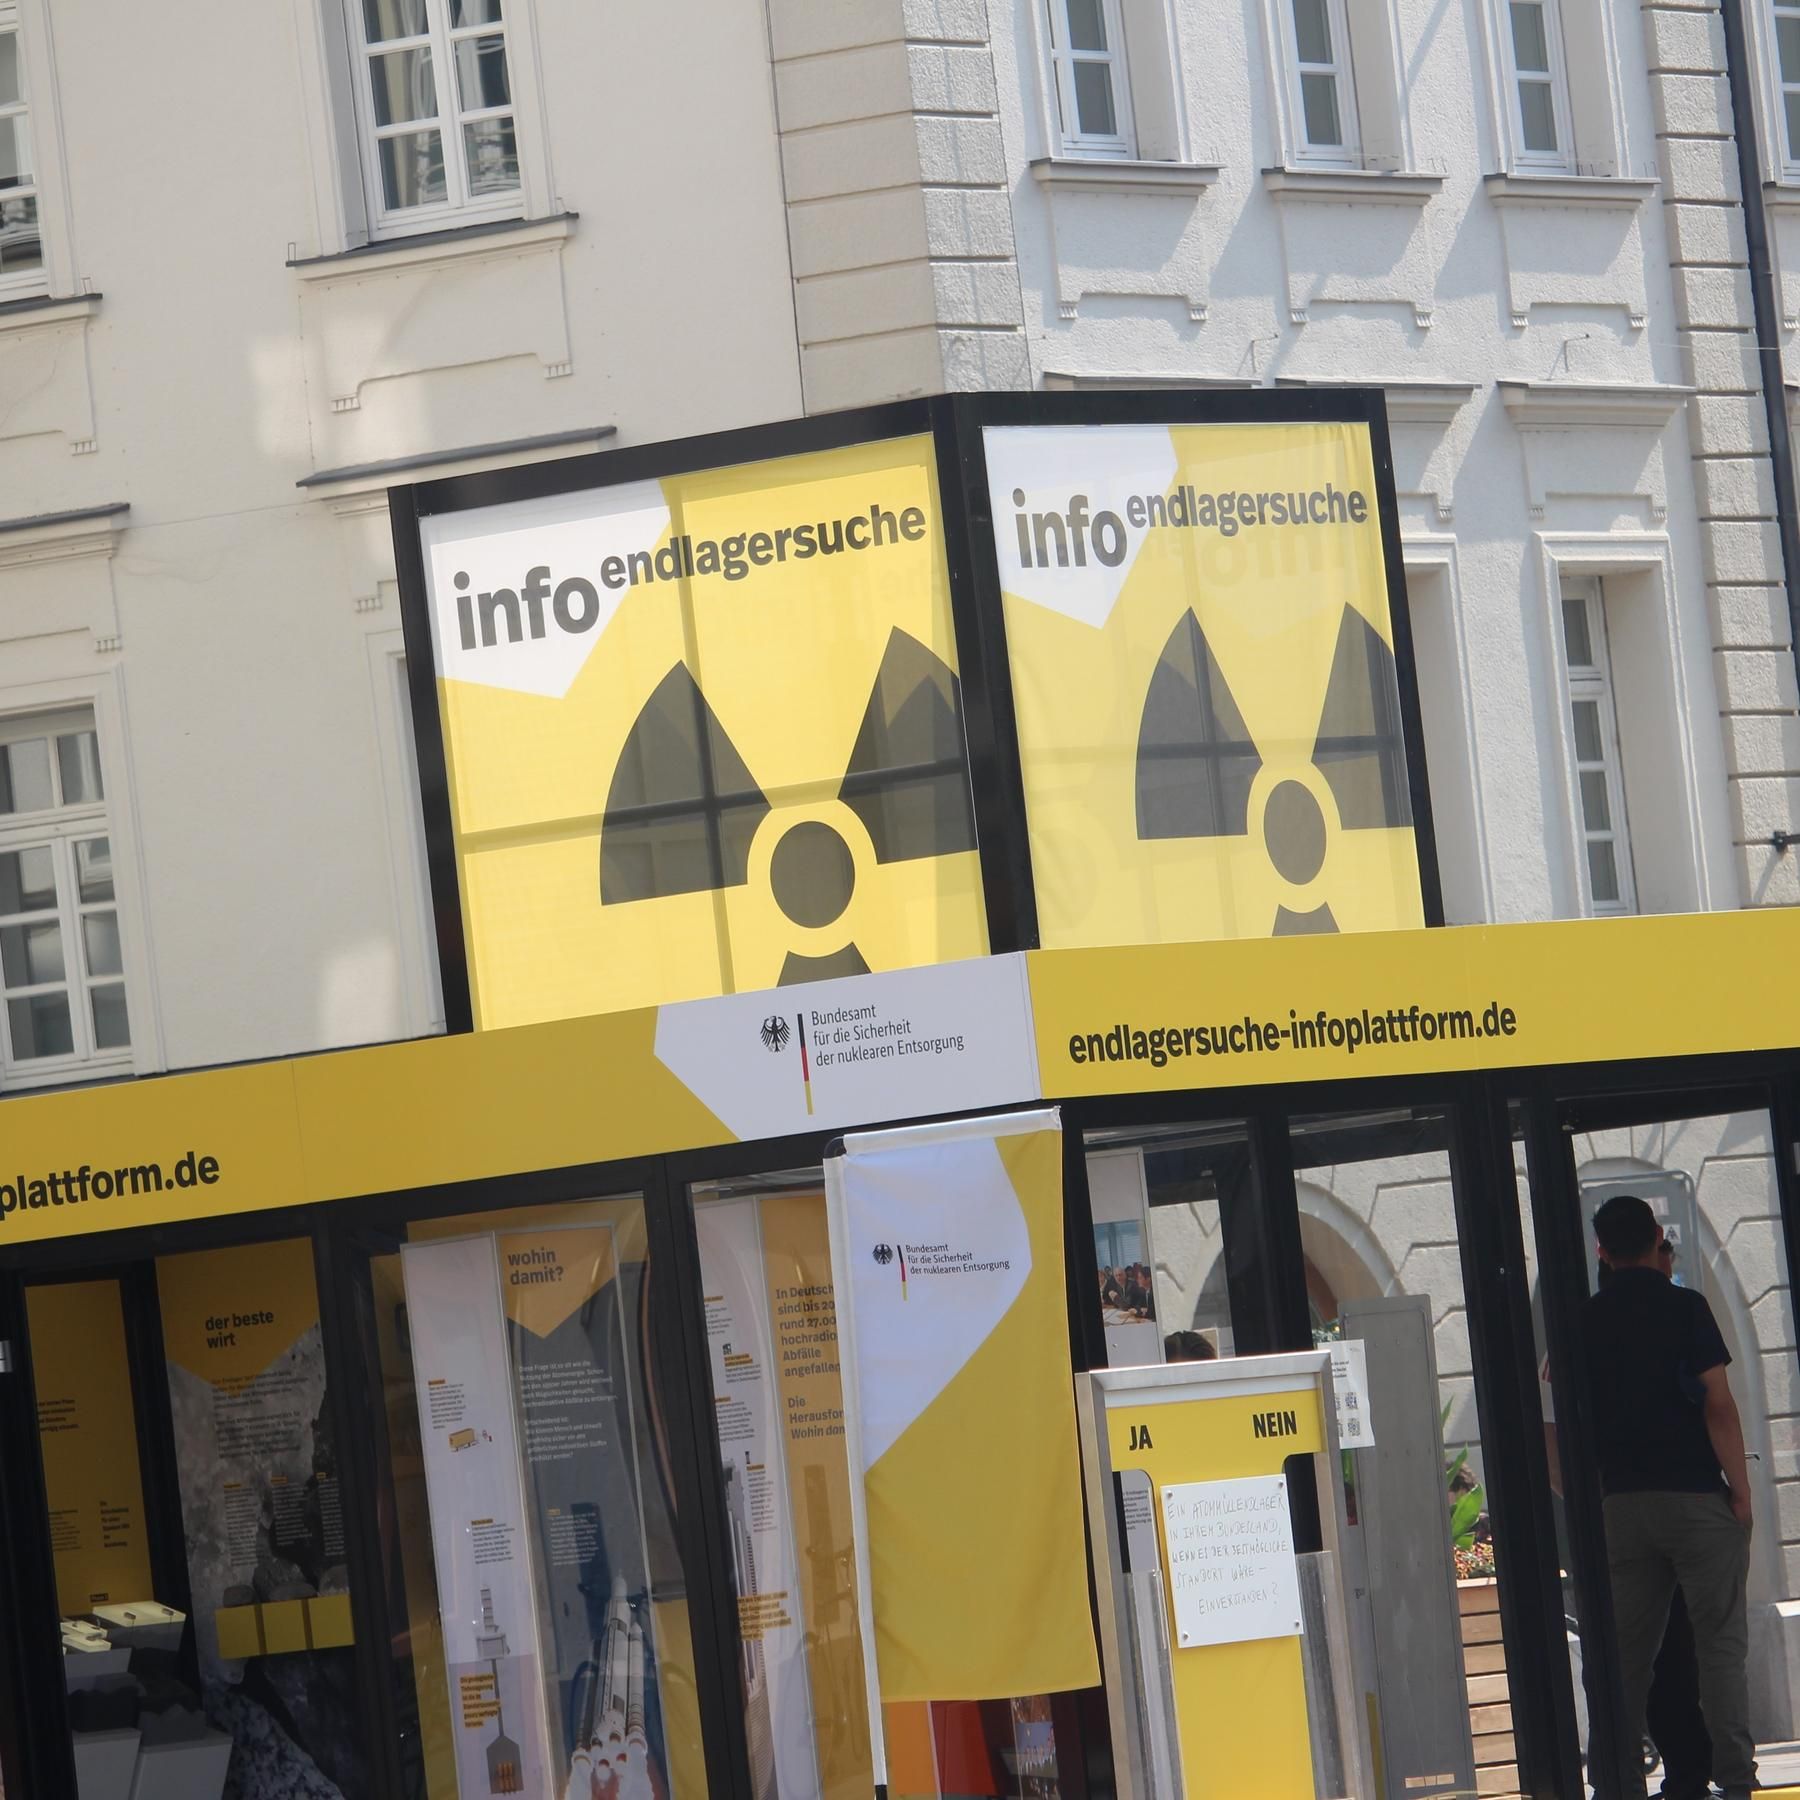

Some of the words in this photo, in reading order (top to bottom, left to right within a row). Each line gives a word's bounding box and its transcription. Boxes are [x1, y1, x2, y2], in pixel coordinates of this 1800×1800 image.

[1012, 488, 1128, 568] info
[1126, 483, 1368, 537] endlagersuche
[453, 566, 600, 650] info
[600, 504, 927, 589] endlagersuche
[811, 1005, 877, 1026] Bundesamt
[813, 1030, 830, 1046] für
[833, 1026, 851, 1044] die
[854, 1019, 912, 1041] Sicherheit
[1069, 1002, 1517, 1067] endlagersuche-infoplattform.de
[816, 1050, 835, 1067] der
[838, 1044, 895, 1064] nuklearen
[898, 1035, 965, 1056] Entsorgung
[0, 1151, 220, 1221] plattform.de
[507, 1246, 556, 1266] wohin
[905, 1243, 949, 1253] Bundesamt
[907, 1254, 919, 1264] für
[920, 1254, 932, 1264] die
[933, 1251, 973, 1263] Sicherheit
[510, 1265, 564, 1285] damit?
[910, 1265, 922, 1275] der
[923, 1264, 962, 1274] nuklearen
[963, 1260, 1011, 1273] Entsorgung
[775, 1288, 788, 1300] In
[777, 1302, 801, 1316] sind
[803, 1300, 820, 1313] bis
[205, 1316, 230, 1331] der
[232, 1311, 274, 1328] beste
[780, 1317, 805, 1330] rund
[206, 1331, 236, 1349] wirt
[783, 1347, 822, 1361] Abfälle
[788, 1396, 806, 1409] Die
[791, 1426, 824, 1440] Wohin
[1252, 1411, 1297, 1438] NEIN
[1129, 1425, 1153, 1451] JA
[1167, 1503, 1186, 1520] EIN
[1169, 1529, 1178, 1541] IN
[1183, 1525, 1214, 1539] IHREM
[1172, 1549, 1196, 1563] WENN
[1211, 1544, 1230, 1557] DER
[1176, 1567, 1225, 1589] STANDORT
